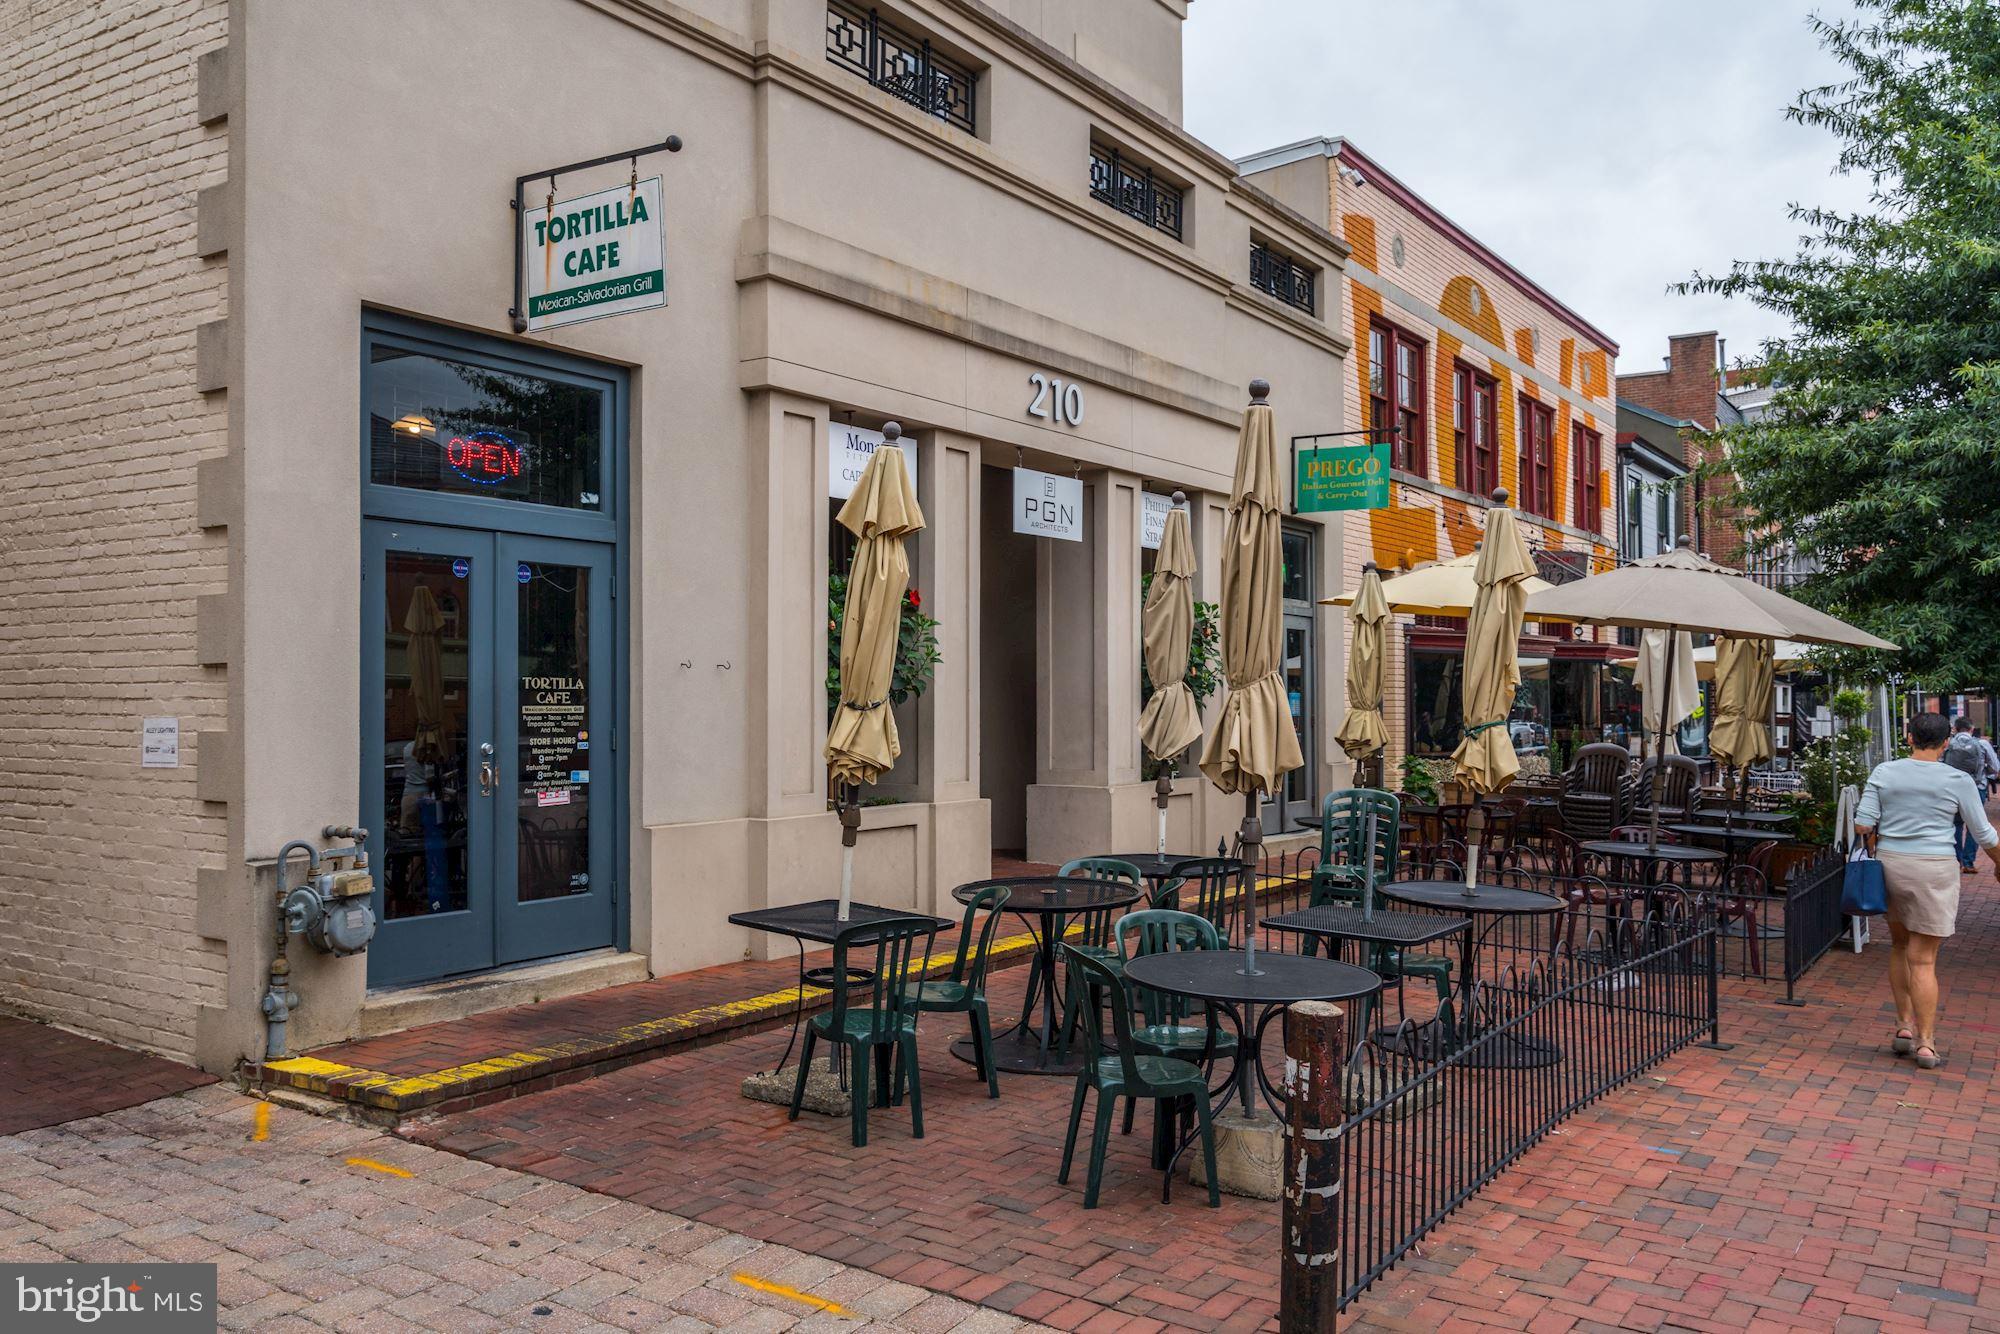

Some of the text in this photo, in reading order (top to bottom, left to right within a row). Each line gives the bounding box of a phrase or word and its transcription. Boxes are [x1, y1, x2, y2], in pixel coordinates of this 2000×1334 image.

[535, 196, 649, 247] TORTILLA
[564, 241, 620, 277] CAFE
[537, 276, 653, 312] Mexican-Salvadorian Grill
[1028, 372, 1084, 427] 210
[448, 437, 520, 476] OPEN
[842, 468, 864, 482] CAP
[1307, 457, 1381, 479] PREGO
[1302, 477, 1385, 491] Italian Gourmet Deli
[1325, 490, 1369, 500] Carry-Out
[1026, 498, 1073, 525] PGN
[1031, 522, 1069, 533] ARCHITECTS
[522, 677, 584, 689] TORTILLA
[536, 692, 571, 704] CAFE
